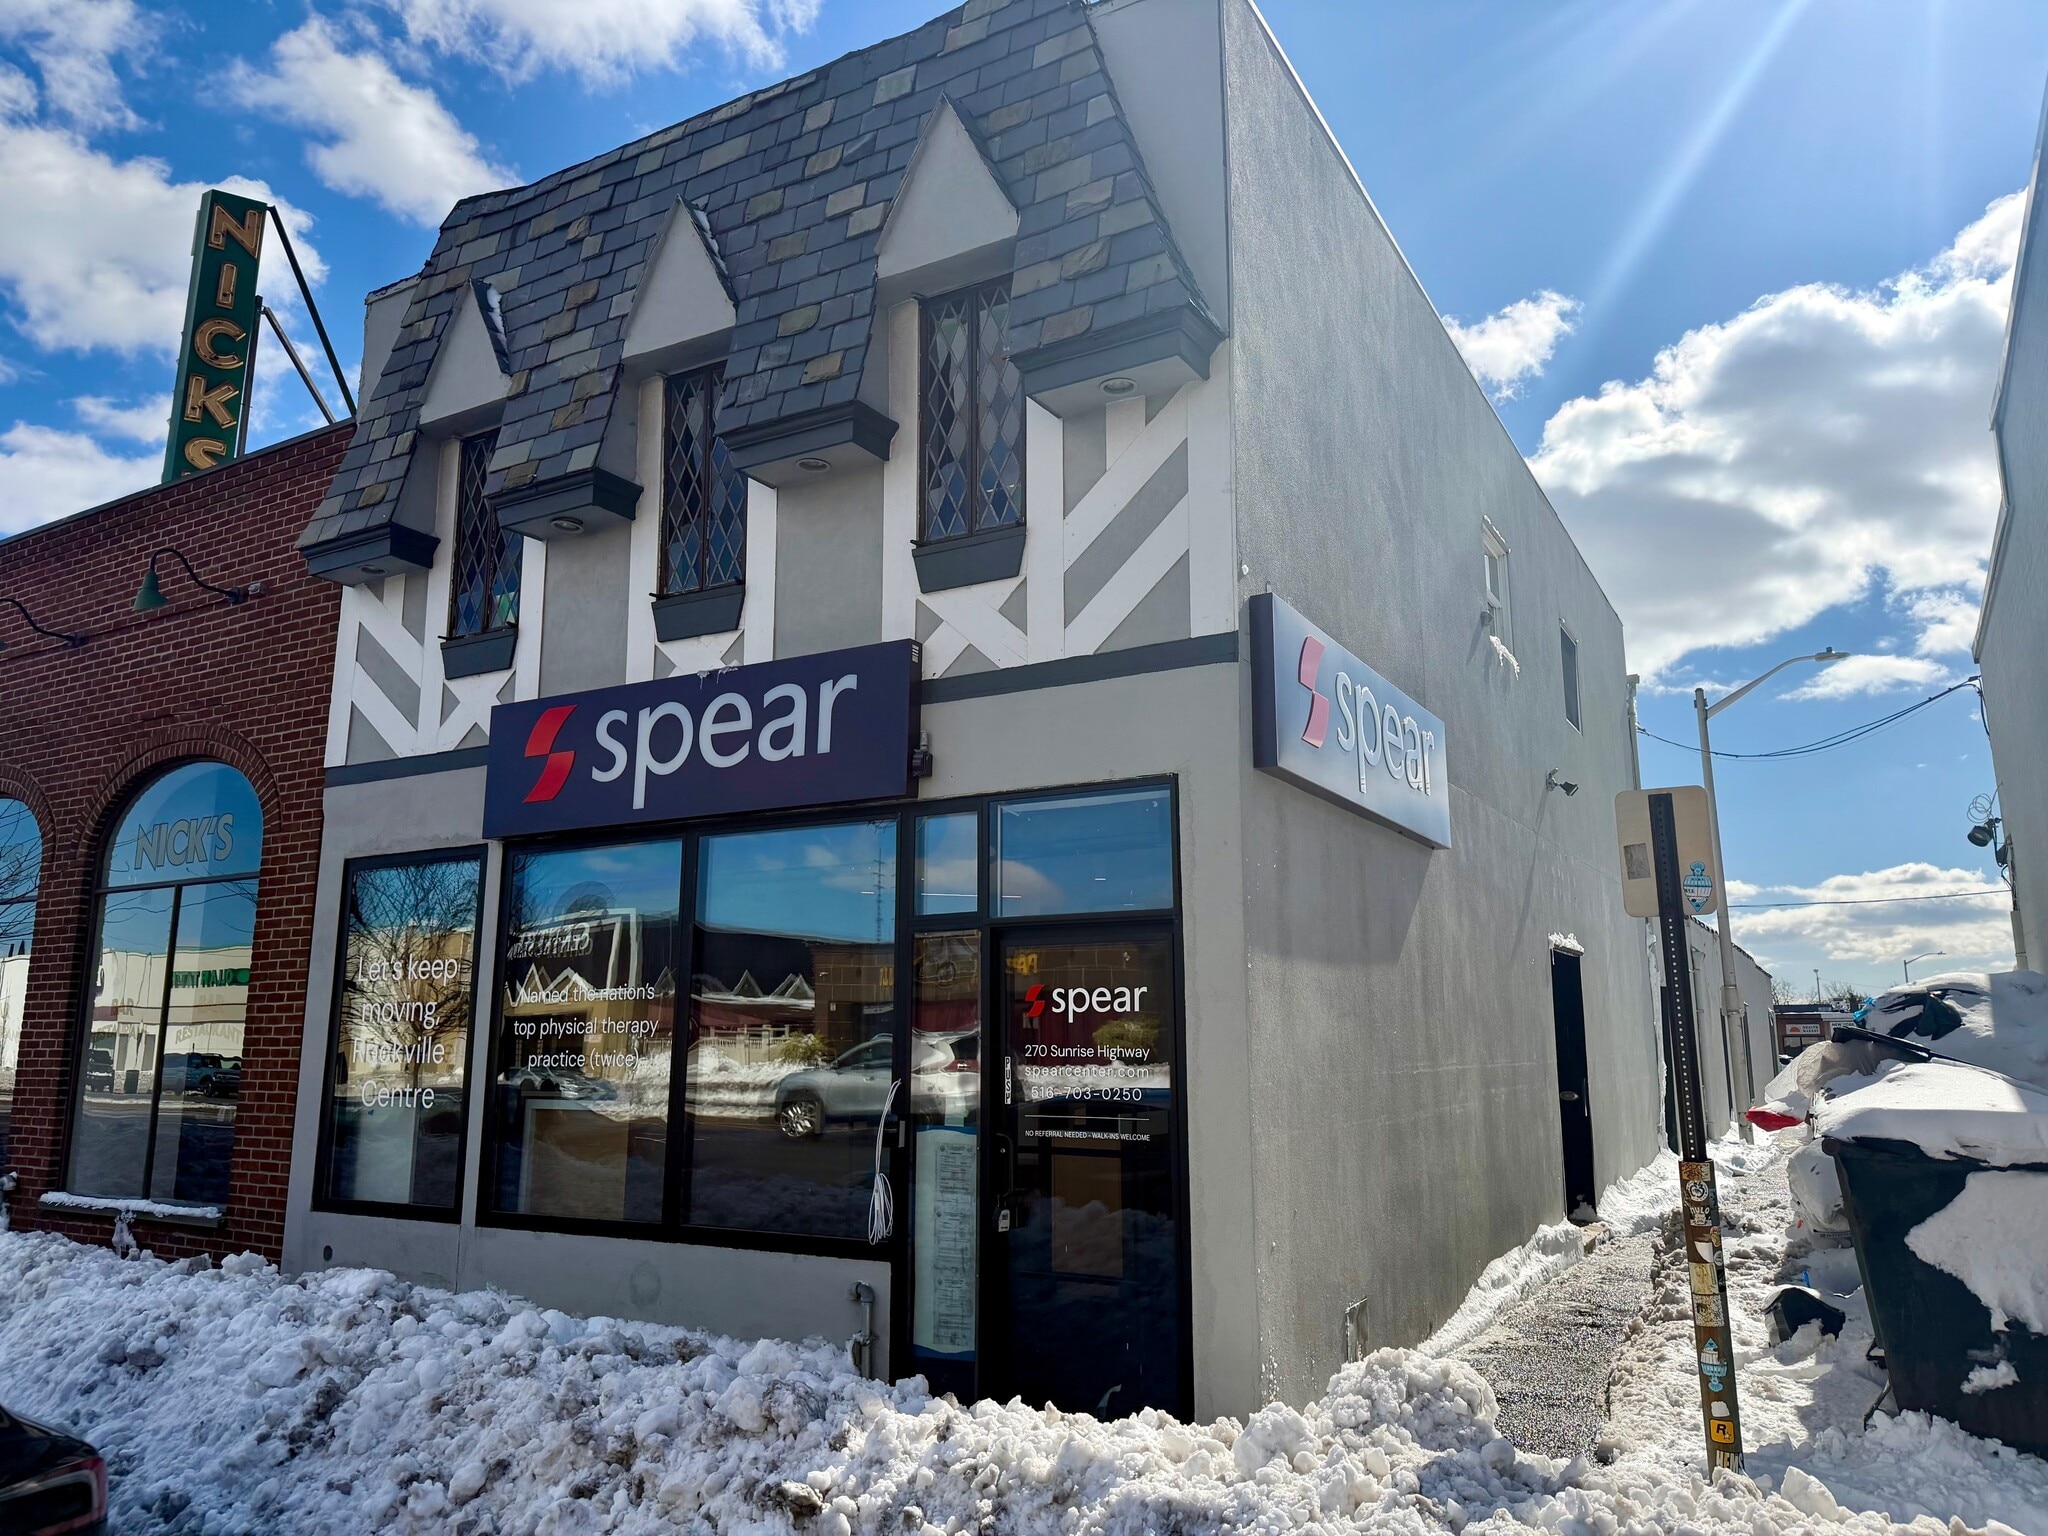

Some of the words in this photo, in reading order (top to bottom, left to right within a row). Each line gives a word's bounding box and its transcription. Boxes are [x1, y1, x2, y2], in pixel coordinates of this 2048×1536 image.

[591, 674, 858, 810] spear
[1335, 672, 1435, 796] spear
[134, 813, 234, 871] NICK'S
[359, 955, 402, 981] Let's
[408, 953, 457, 986] keep
[520, 985, 568, 1003] Named
[573, 986, 595, 1001] the
[600, 983, 655, 1000] nation's
[1052, 986, 1147, 1023] spear
[110, 998, 134, 1016] BAR
[362, 995, 440, 1029] moving,
[175, 1023, 242, 1044] RESTAURANT
[514, 1021, 536, 1039] top
[540, 1017, 597, 1039] physical
[602, 1017, 659, 1037] therapy
[352, 1036, 445, 1064] Rockville
[528, 1050, 585, 1071] practice
[590, 1047, 639, 1070] (twice)
[1025, 1045, 1047, 1057] 270
[1051, 1045, 1094, 1057] Sunrise
[1097, 1045, 1150, 1061] Highway
[1025, 1066, 1149, 1079] spearcenter.com
[361, 1080, 435, 1108] Centre
[1031, 1086, 1142, 1101] 516-703-0250
[1035, 1130, 1063, 1138] REFERRAL
[1064, 1131, 1088, 1139] NEEDED
[1120, 1133, 1151, 1141] WELCOME
[1716, 1424, 1727, 1435] R
